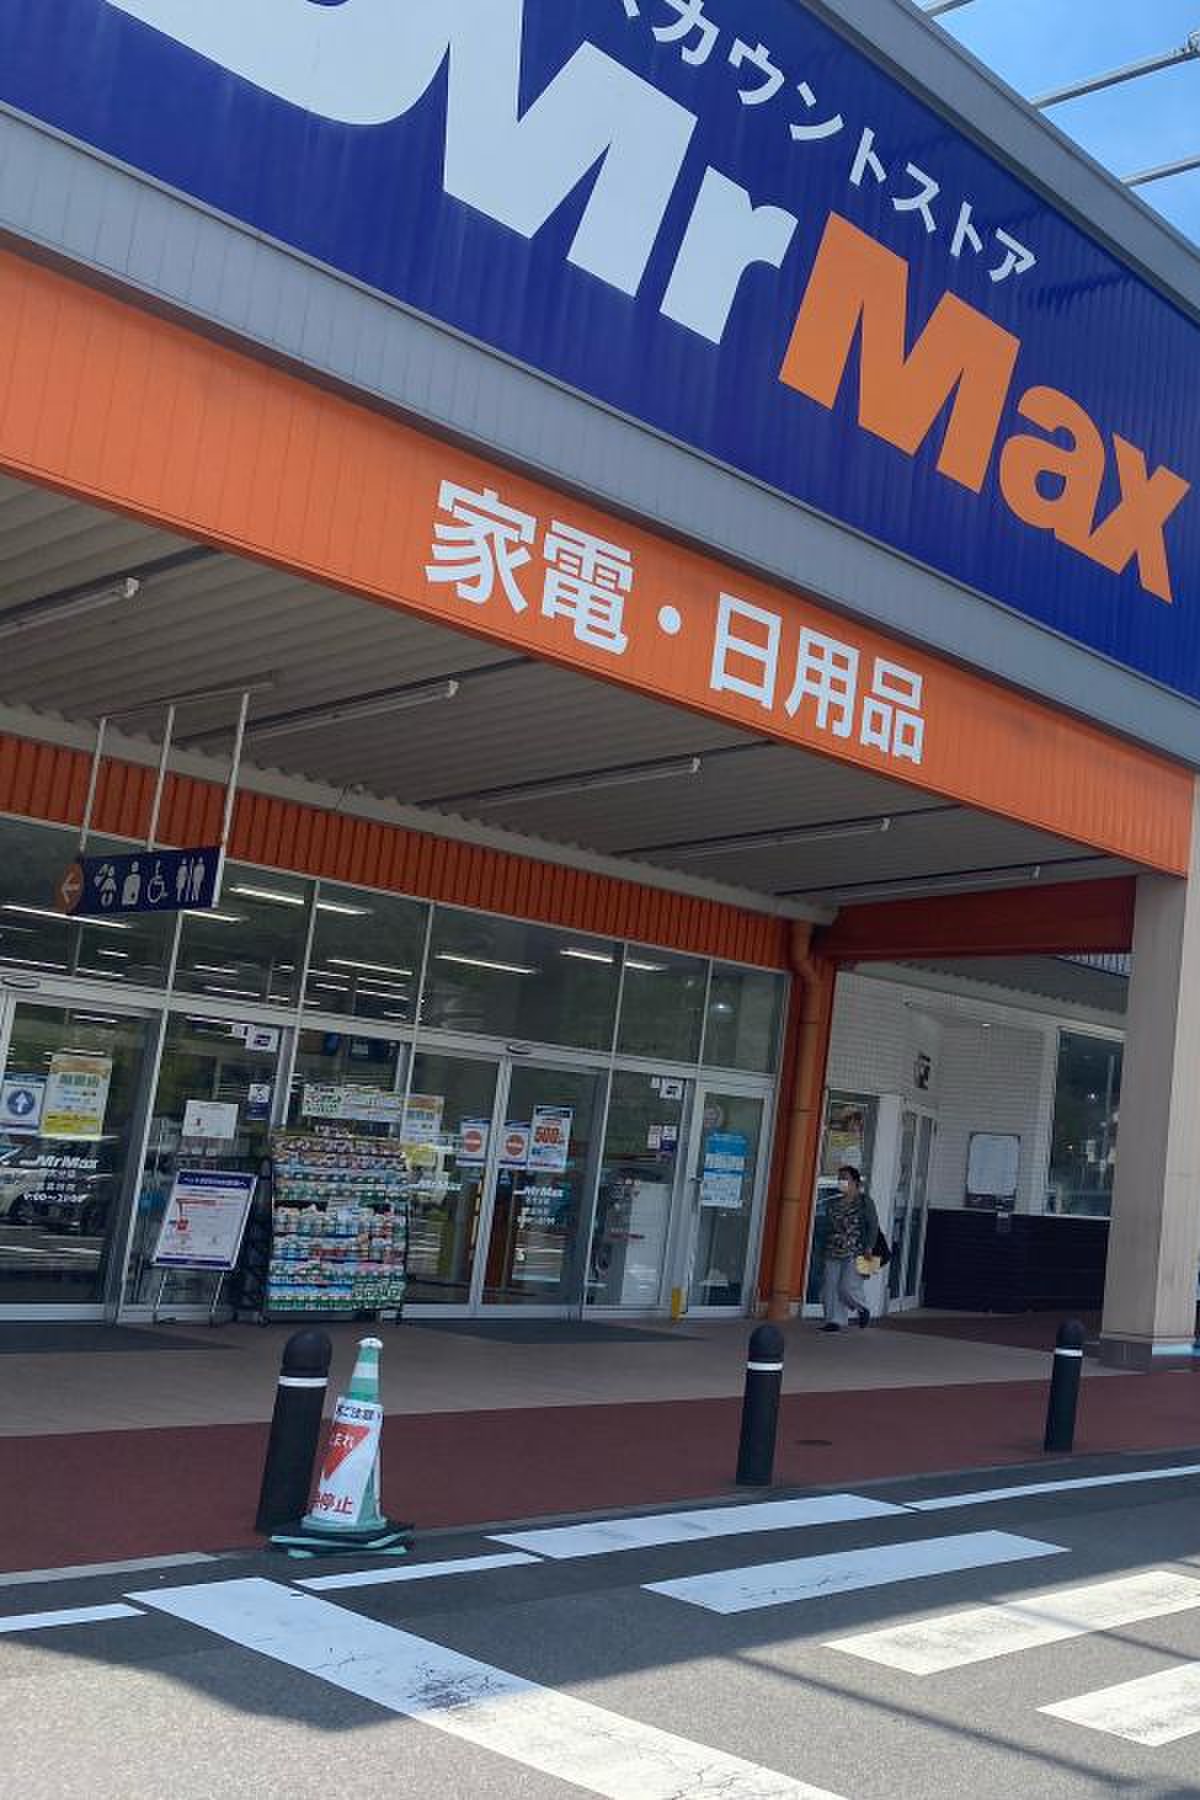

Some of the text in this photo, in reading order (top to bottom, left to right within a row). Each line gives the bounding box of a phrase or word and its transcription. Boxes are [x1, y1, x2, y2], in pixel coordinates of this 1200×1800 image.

[425, 480, 925, 765] 家電・日用品
